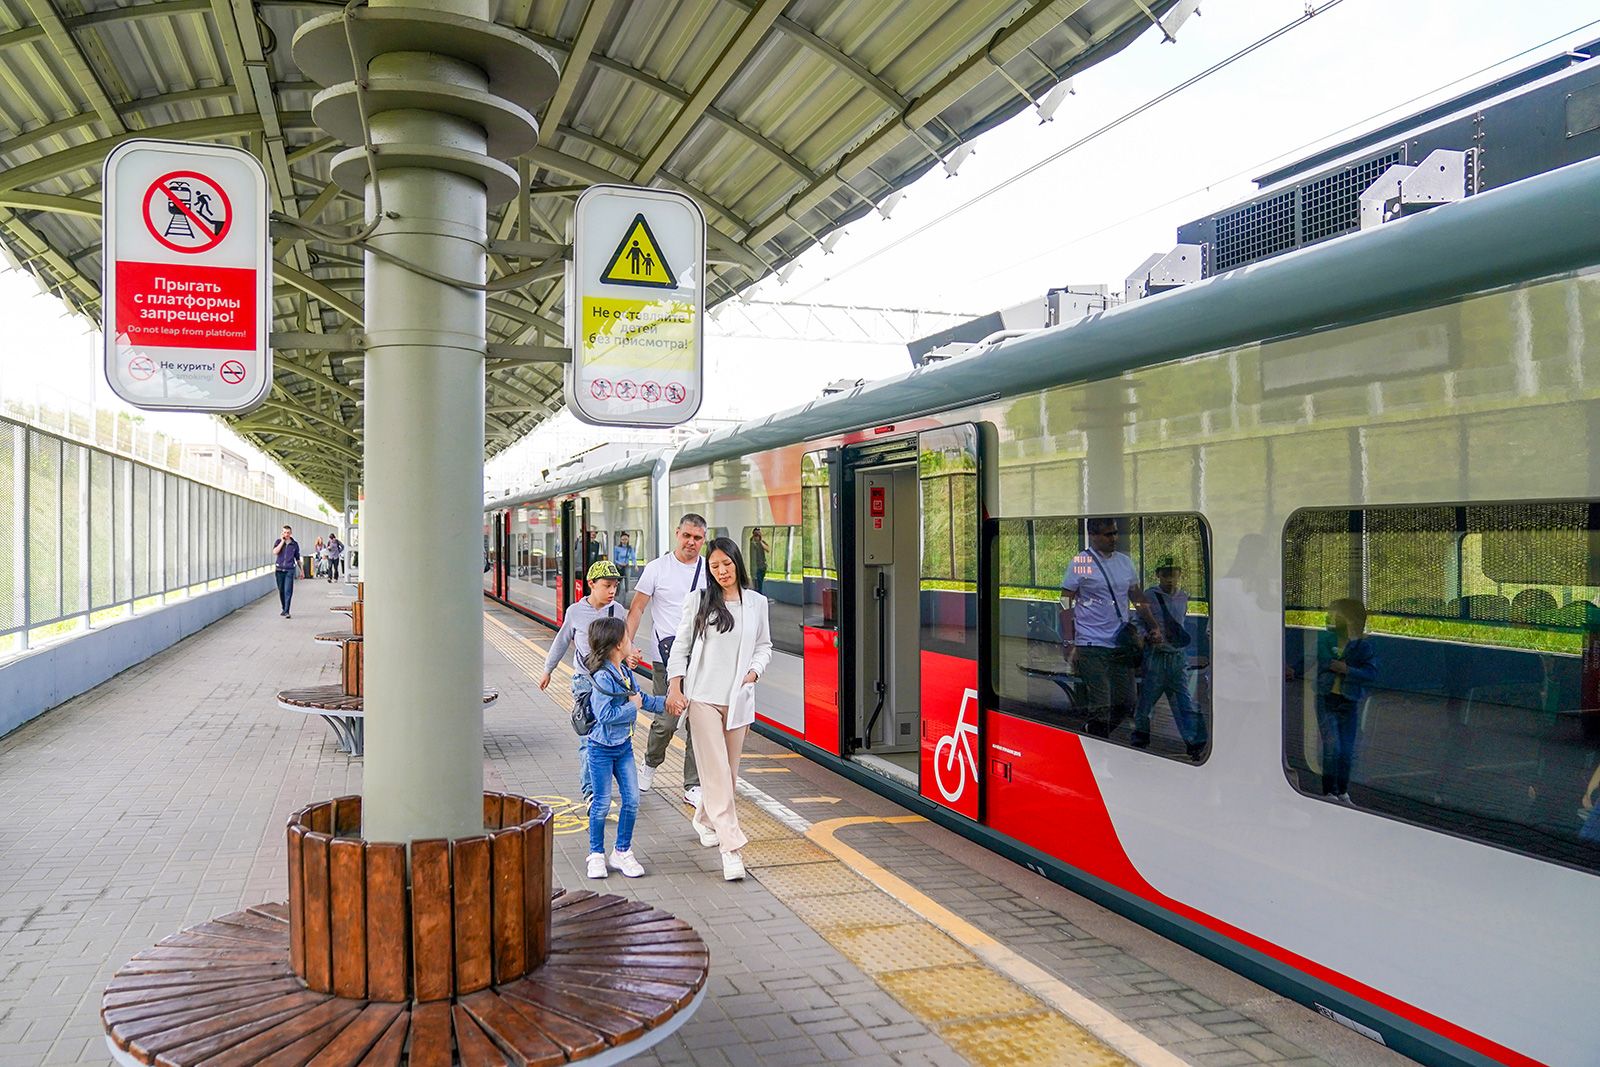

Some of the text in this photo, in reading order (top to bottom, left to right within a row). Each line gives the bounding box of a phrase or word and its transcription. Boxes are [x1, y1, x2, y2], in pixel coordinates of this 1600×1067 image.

[154, 277, 221, 293] Прыгать
[133, 294, 241, 309] с платформы
[140, 309, 234, 323] запрещено!
[592, 306, 685, 323] Не оставляйте
[160, 327, 179, 336] leap
[181, 328, 204, 336] from
[205, 329, 247, 338] platform!
[620, 323, 658, 334] детей
[588, 332, 688, 350] без присмотра!
[160, 361, 216, 372] Не курить!
